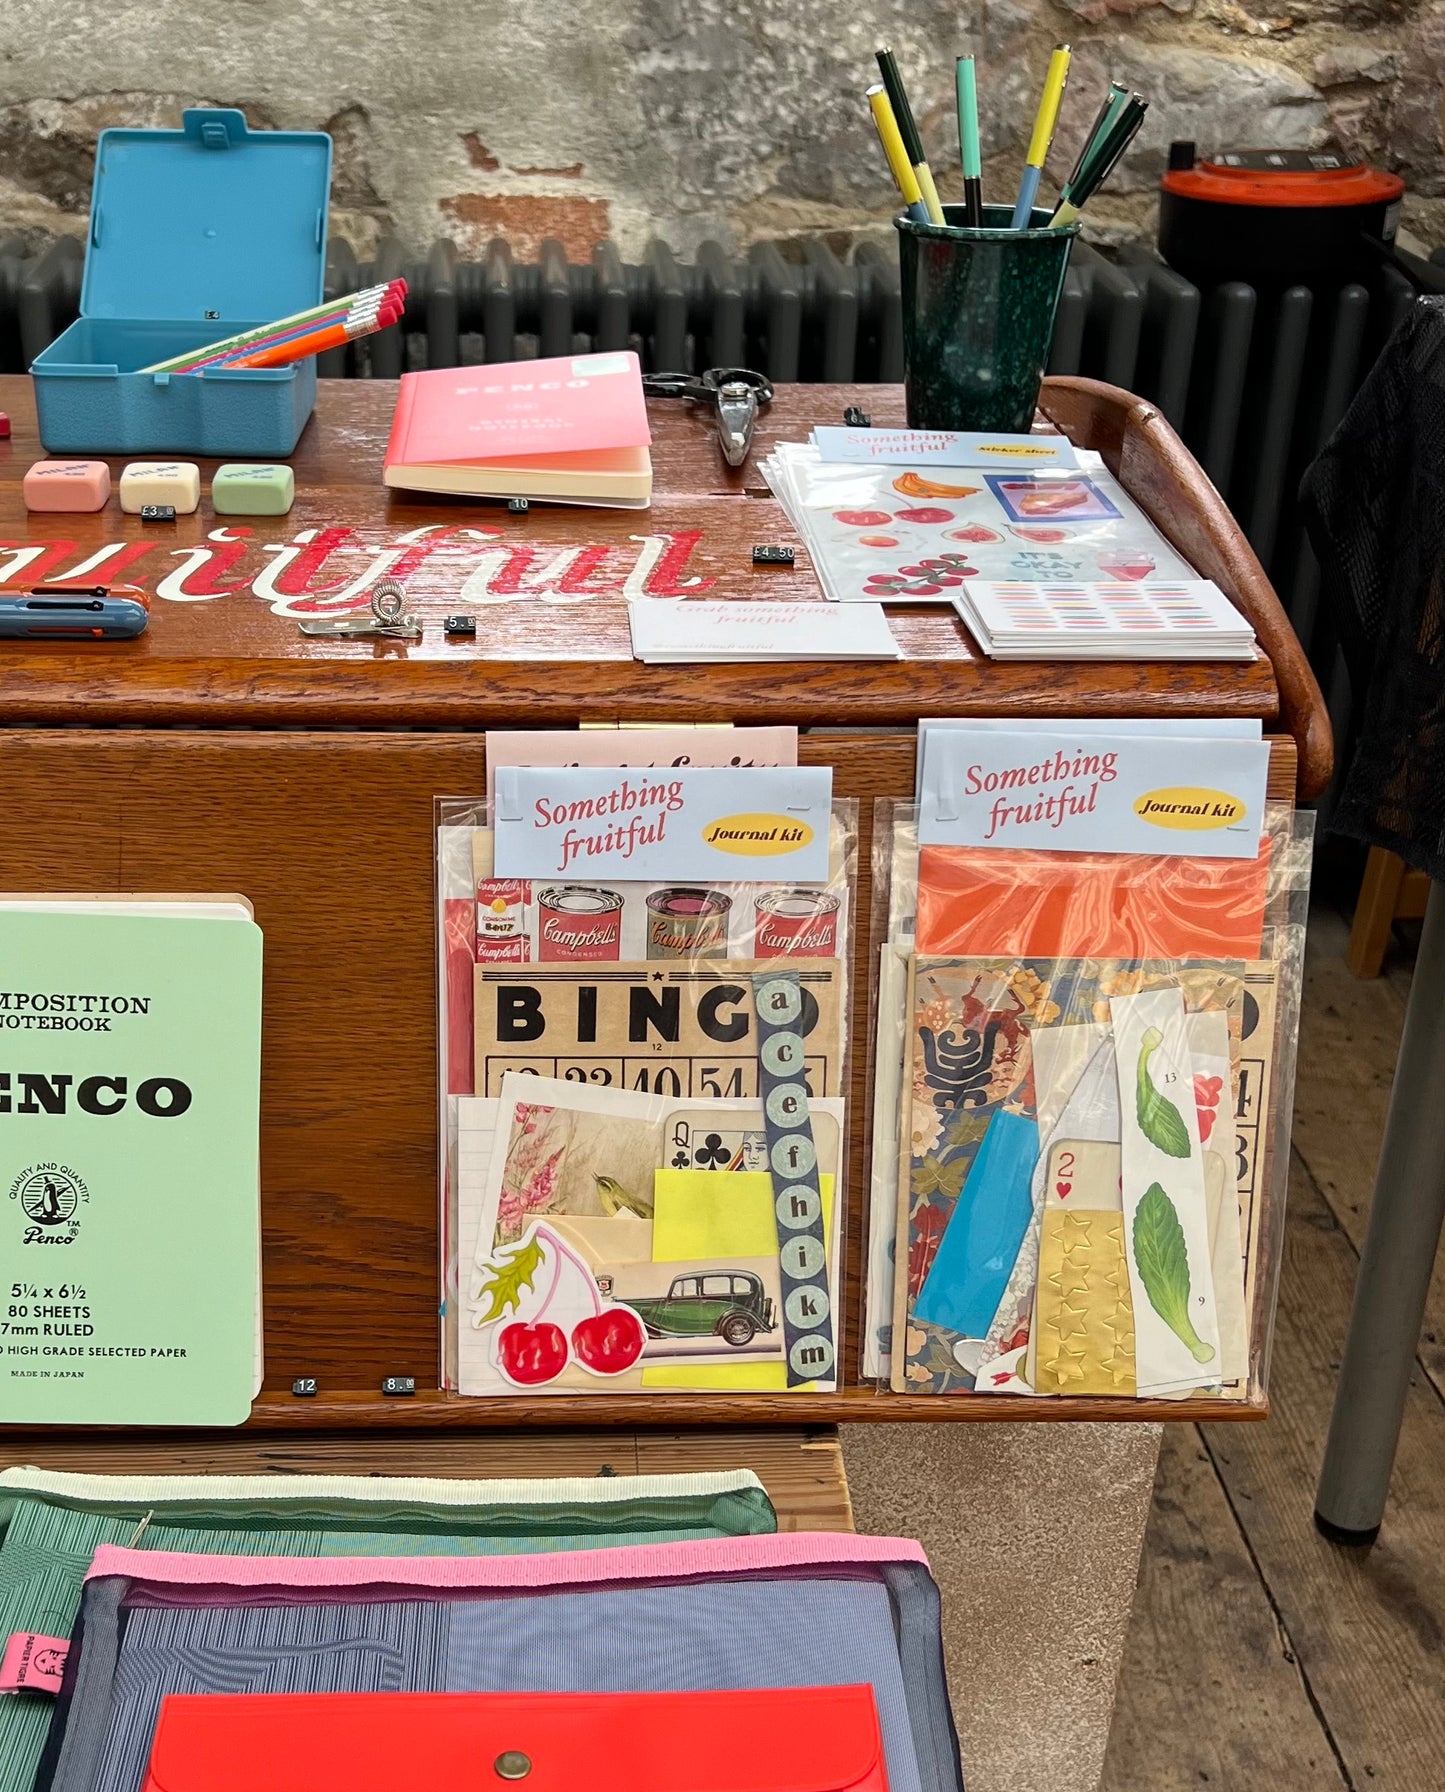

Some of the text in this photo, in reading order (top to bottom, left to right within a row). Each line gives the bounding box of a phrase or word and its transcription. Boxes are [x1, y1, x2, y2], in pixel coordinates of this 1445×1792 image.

[848, 432, 958, 443] Something
[870, 442, 948, 456] fruitful
[513, 499, 528, 509] 10
[754, 546, 794, 558] £4.50
[0, 525, 717, 618] uitful
[1010, 561, 1082, 570] OKAY
[1041, 570, 1073, 579] TO
[675, 604, 839, 616] Grab something
[714, 615, 797, 625] fruitful
[964, 748, 1118, 796] Something
[533, 778, 684, 828] Something
[984, 783, 1098, 839] fruitful
[1138, 799, 1237, 818] Journal kit
[557, 812, 666, 872] fruitful
[708, 826, 804, 843] Journal kit
[544, 918, 616, 951] Campbell's
[759, 923, 832, 954] Campbell's
[771, 989, 790, 1010] a
[0, 1014, 112, 1031] OTEBOOK
[652, 1043, 662, 1051] 12
[777, 1042, 793, 1060] c
[1163, 1072, 1177, 1084] 13
[0, 1073, 192, 1117] NCO
[781, 1094, 798, 1114] e
[671, 1120, 690, 1148] Q
[787, 1145, 799, 1167] f
[1057, 1152, 1075, 1178] 2
[9, 1162, 90, 1204] QUALITY AND QUANTITY
[790, 1196, 807, 1217] h
[797, 1245, 806, 1268] i
[43, 1287, 54, 1299] x
[1198, 1296, 1206, 1306] 9
[8, 1305, 91, 1319] 80 SHEETS
[800, 1295, 818, 1316] k
[1, 1322, 94, 1337] 7mm RULED
[7, 1345, 39, 1356] HIGH
[42, 1346, 84, 1356] GRADE
[88, 1347, 146, 1358] SELECTED
[150, 1348, 187, 1358] PAPER
[800, 1345, 825, 1365] m
[10, 1370, 38, 1378] MADE
[299, 1379, 315, 1391] 12
